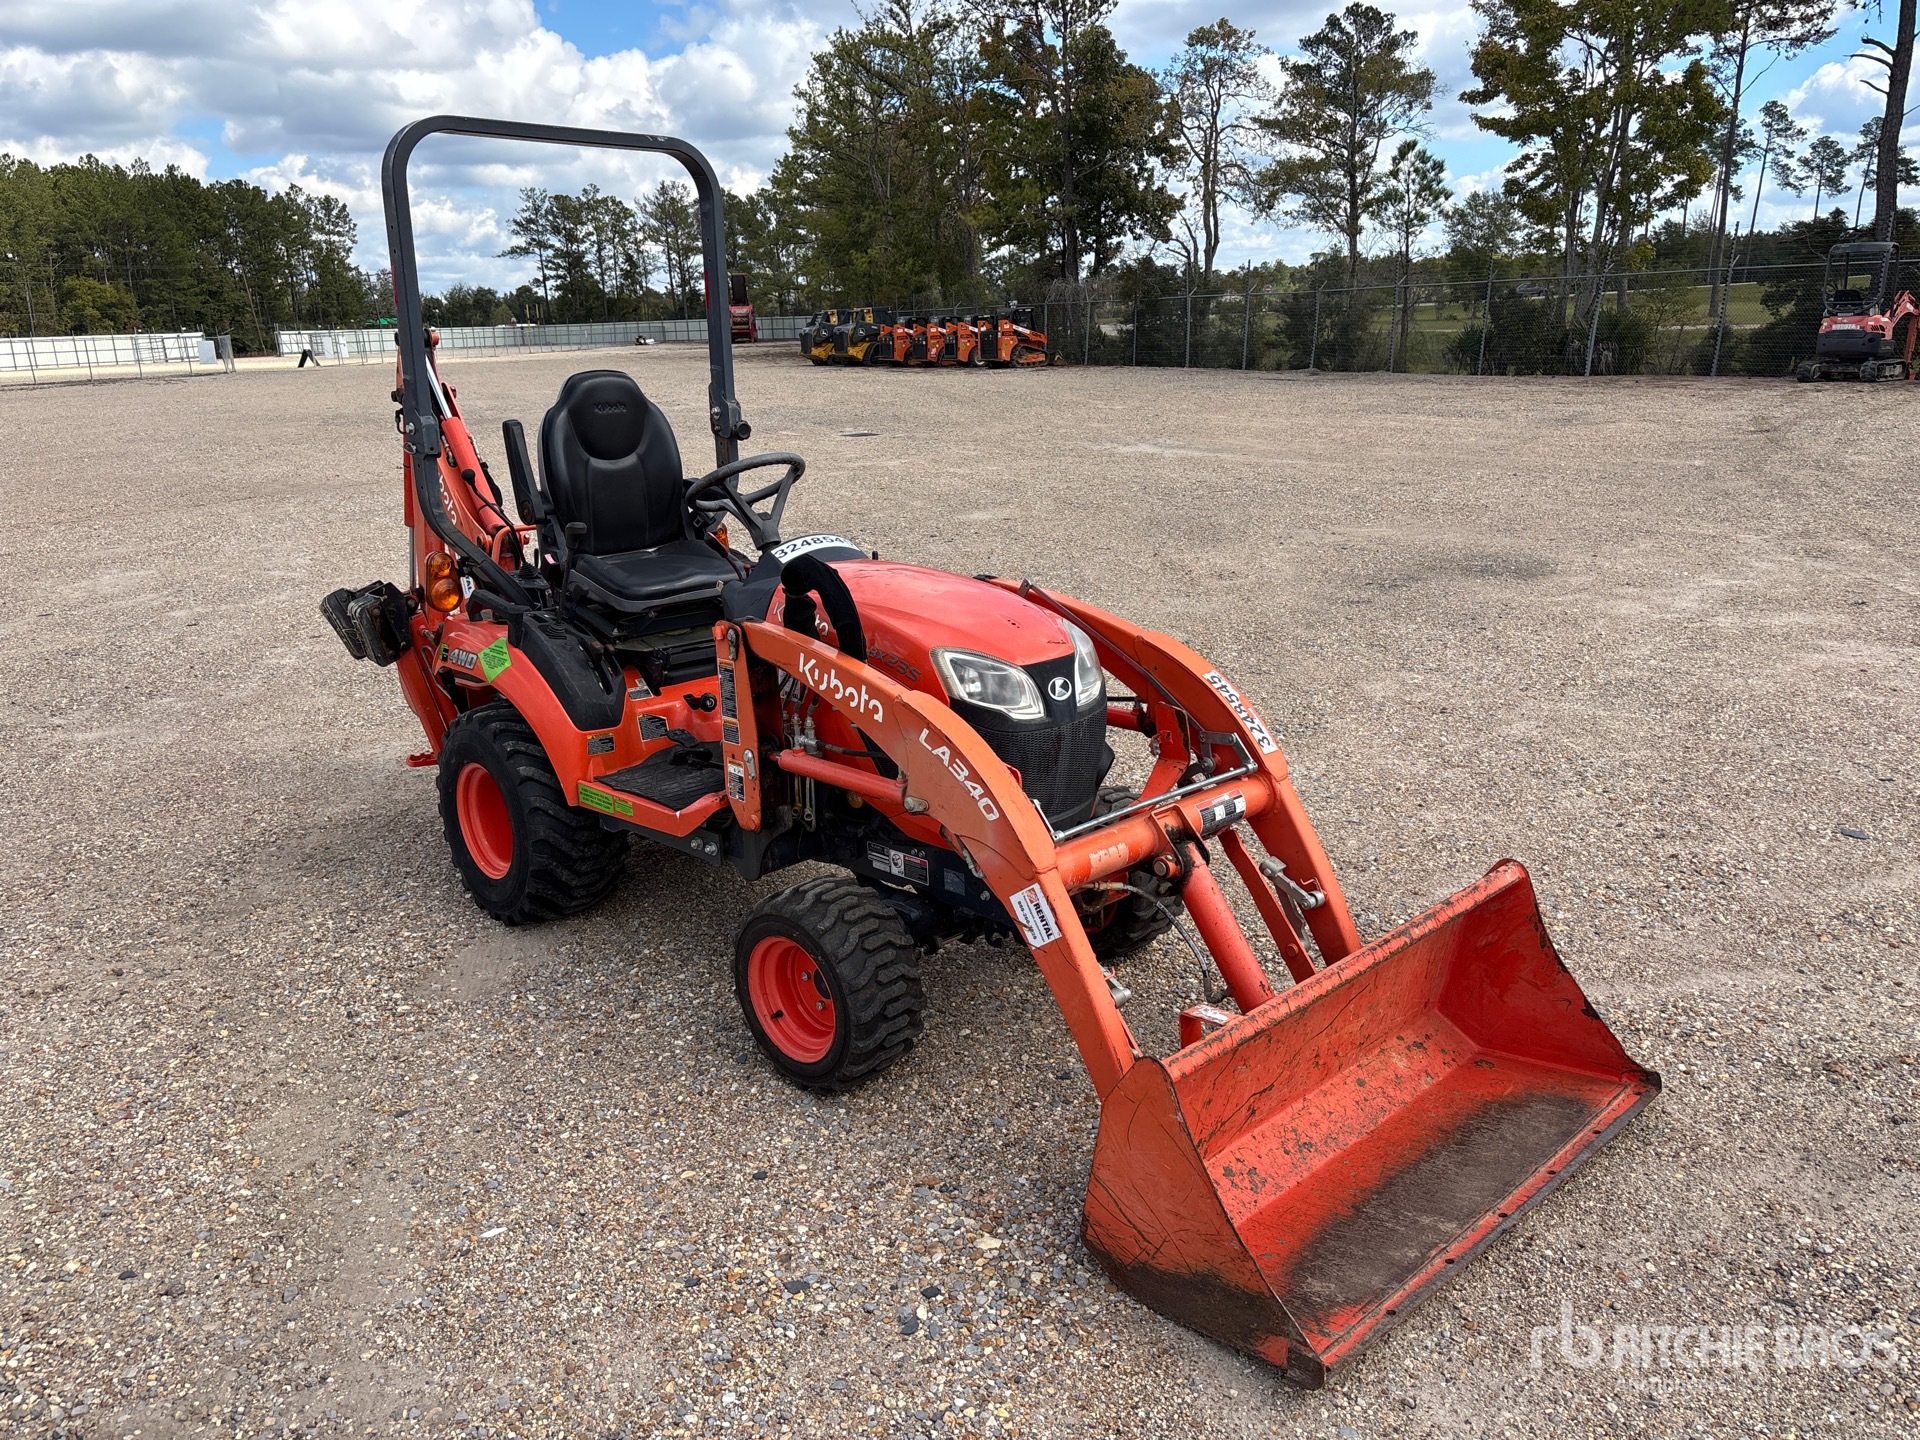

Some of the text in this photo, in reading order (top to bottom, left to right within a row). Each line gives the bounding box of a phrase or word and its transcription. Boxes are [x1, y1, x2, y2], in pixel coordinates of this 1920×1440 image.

[438, 474, 457, 526] bota
[773, 601, 829, 637] Kta
[449, 648, 478, 670] 4WD
[867, 646, 922, 682] BX23S
[798, 652, 884, 723] Kubota
[1207, 675, 1271, 749] 3248545
[918, 727, 1000, 821] LA340
[1017, 900, 1037, 940] 888-266-28
[1033, 902, 1053, 940] RENTAL
